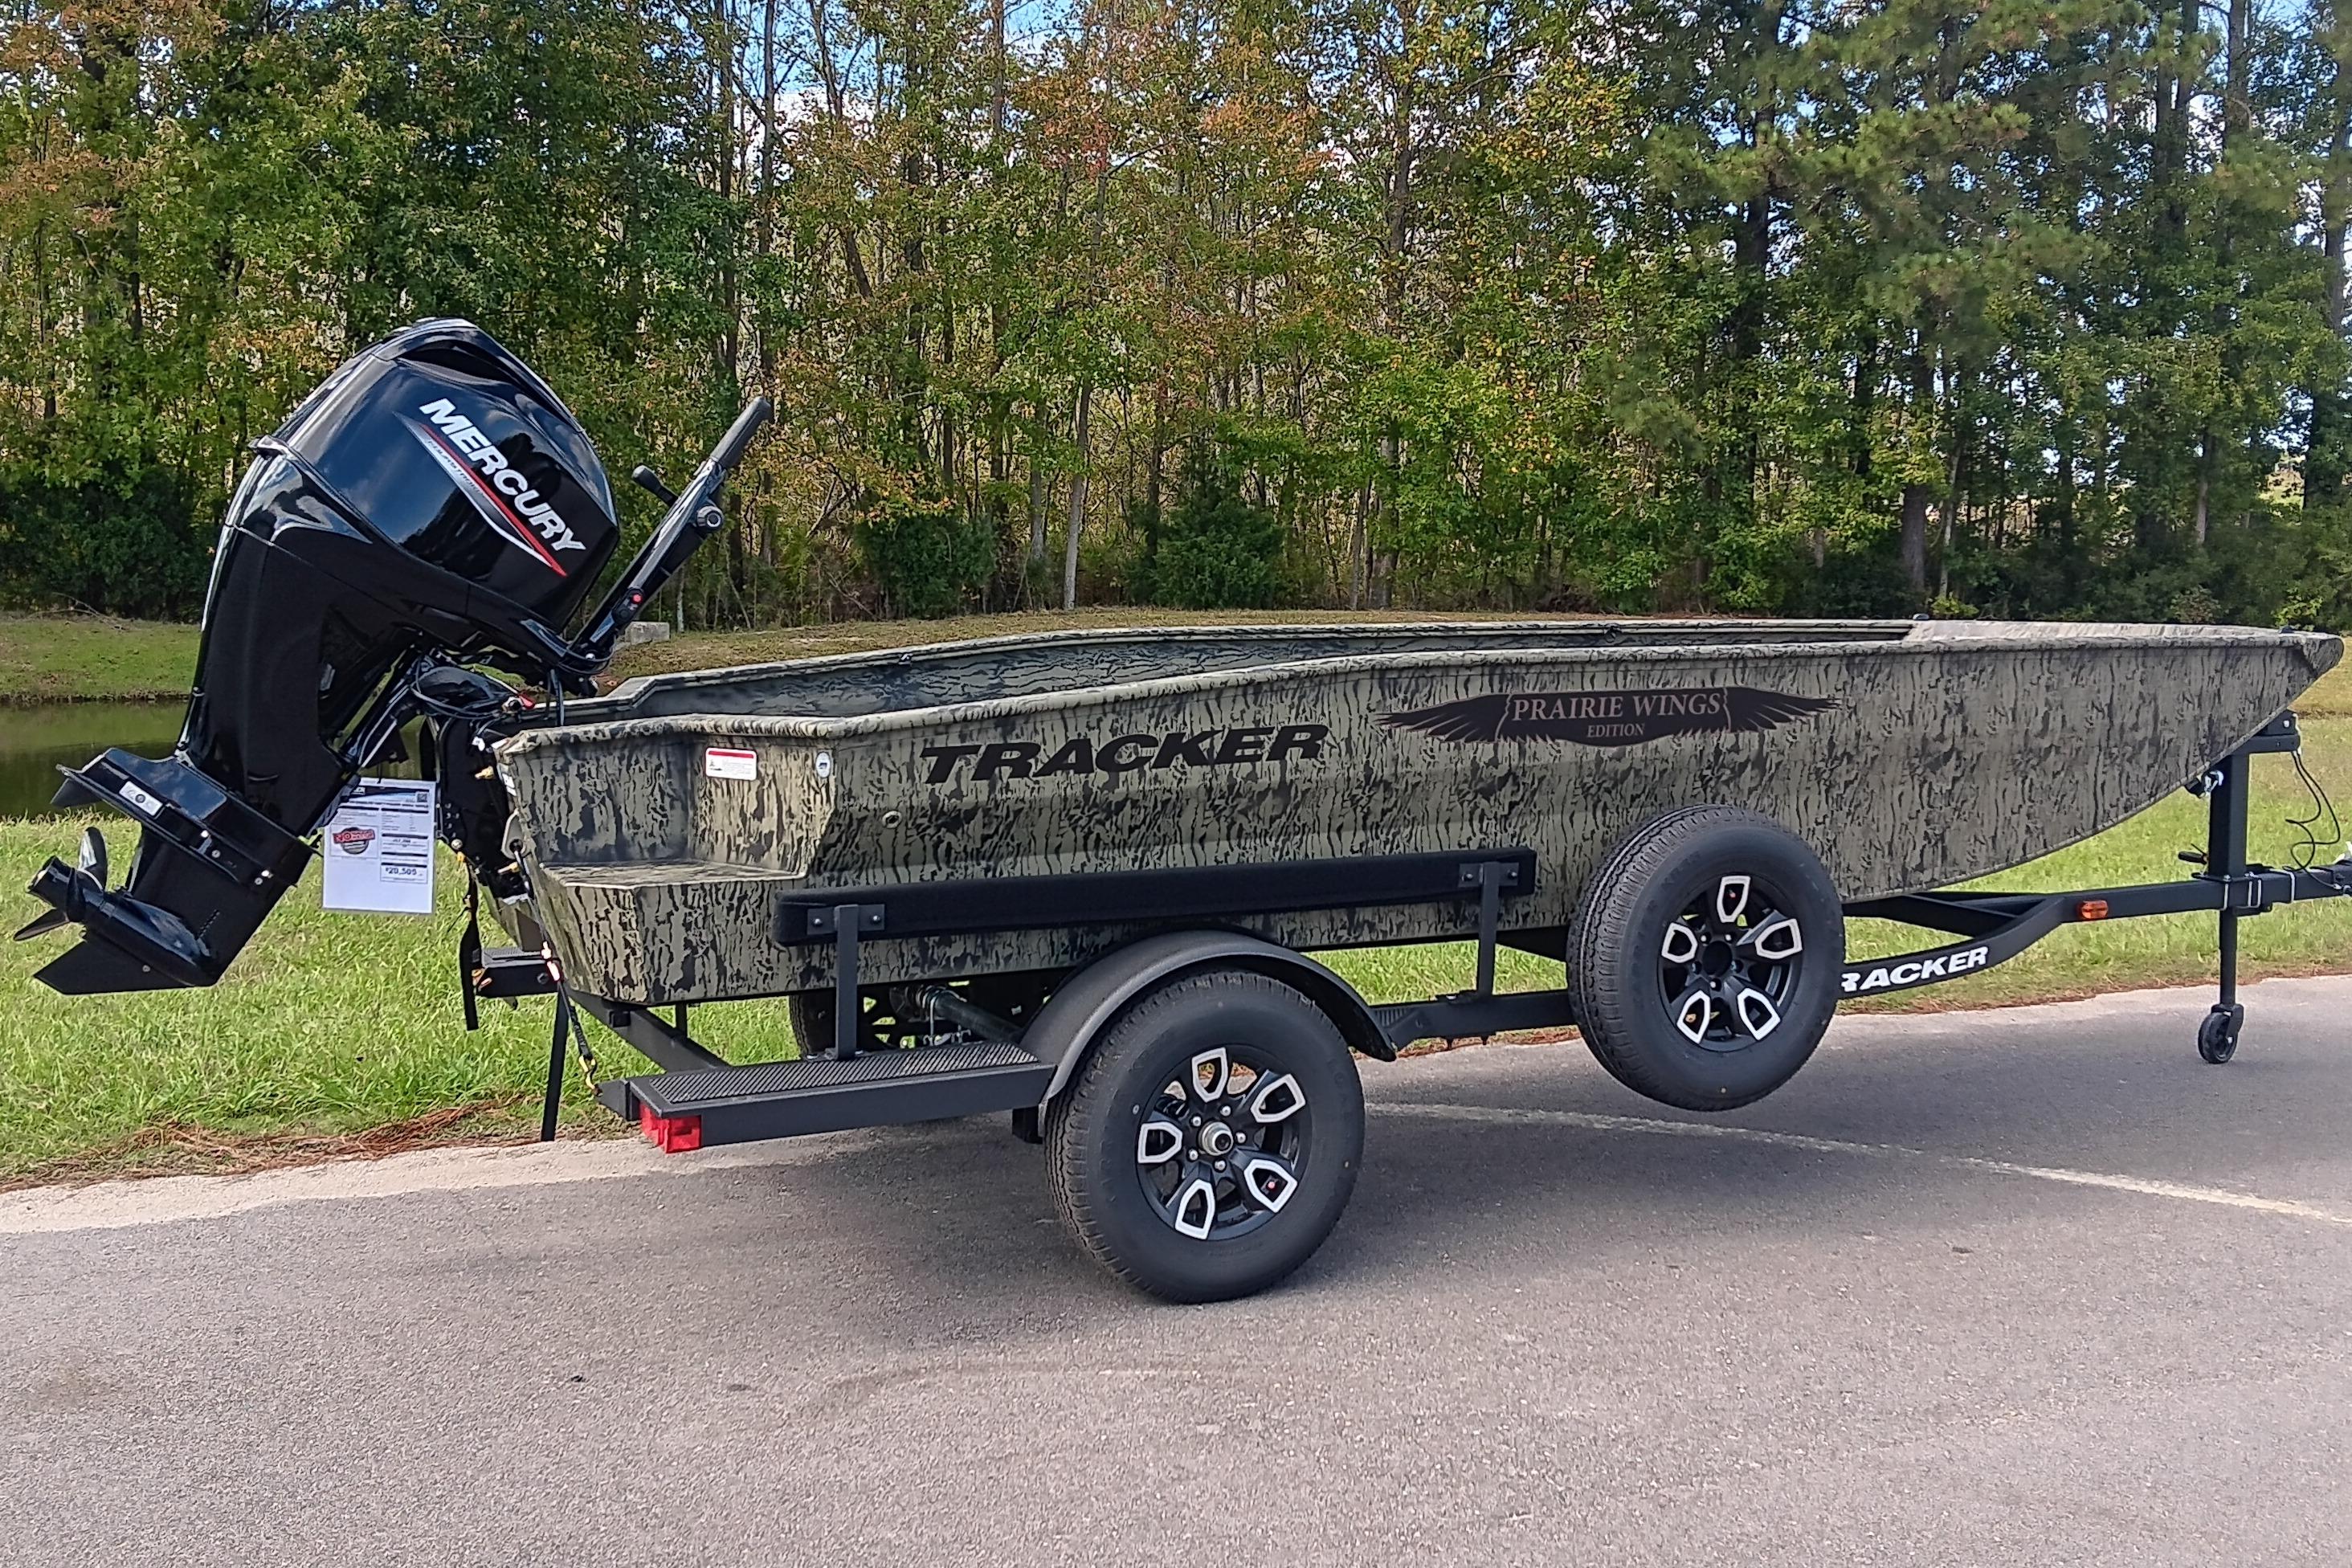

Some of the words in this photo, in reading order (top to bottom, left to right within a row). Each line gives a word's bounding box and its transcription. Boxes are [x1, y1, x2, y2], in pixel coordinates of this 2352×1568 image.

[419, 398, 586, 551] MERCURY
[1512, 696, 1623, 721] PRAIRIE
[1632, 693, 1721, 717] WINGS
[1586, 723, 1645, 737] EDITION
[920, 725, 1329, 784] TRACKER
[1841, 946, 1989, 992] RACKER
